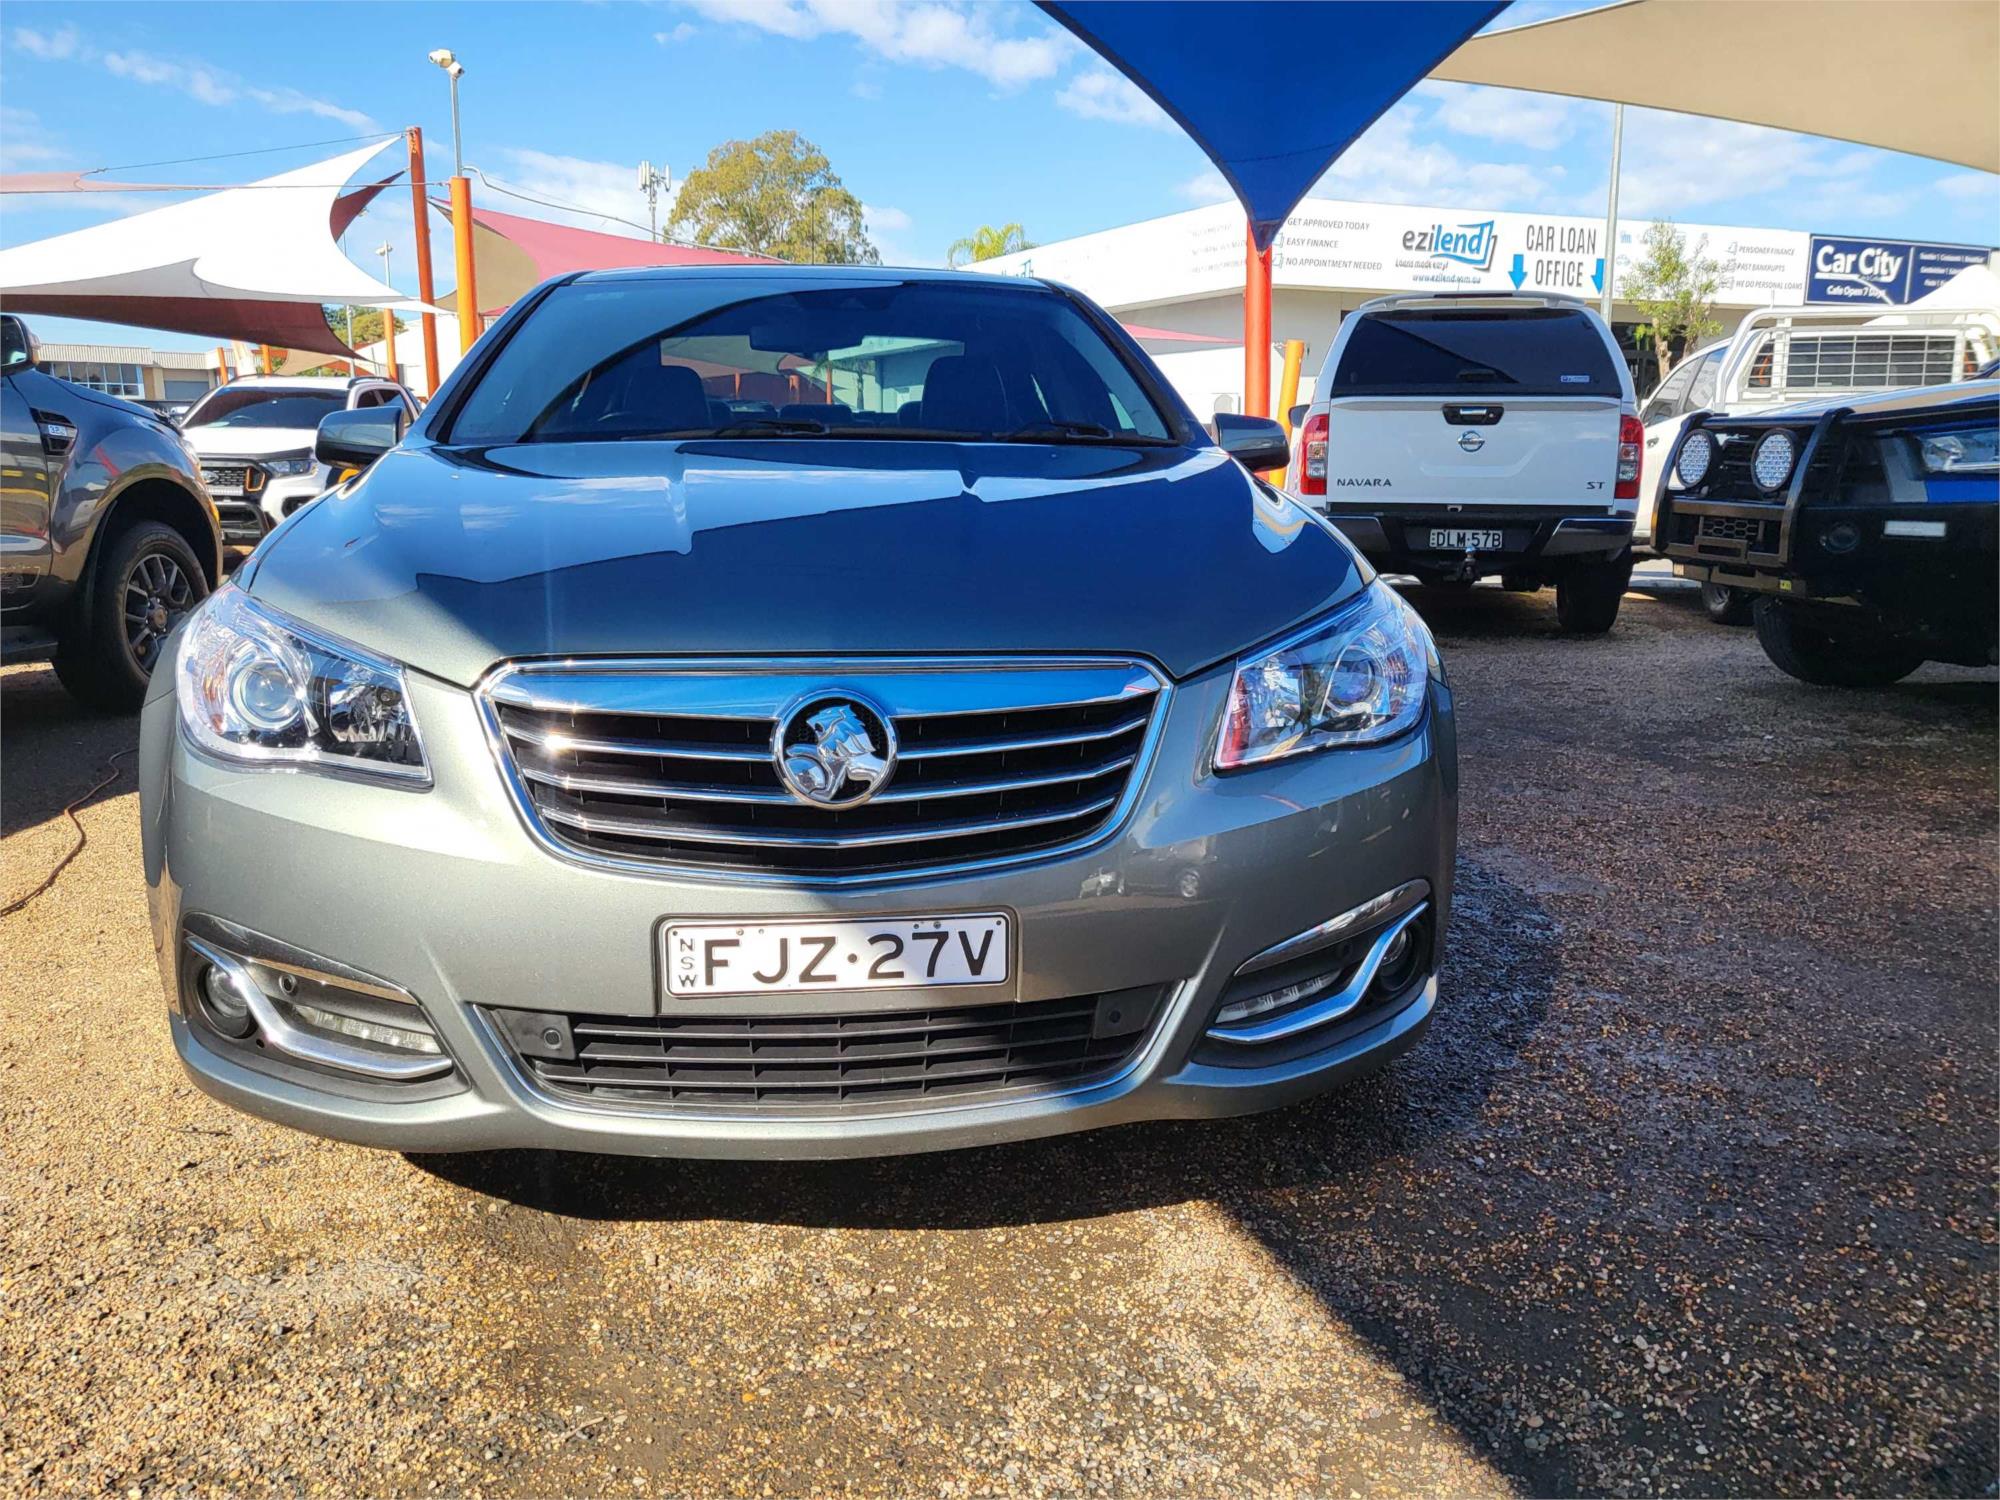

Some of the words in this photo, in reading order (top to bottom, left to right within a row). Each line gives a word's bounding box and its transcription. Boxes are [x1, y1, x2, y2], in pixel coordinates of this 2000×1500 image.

[1287, 217, 1302, 226] GET
[1303, 218, 1344, 230] APPROVED
[1345, 221, 1370, 231] TODAY
[1286, 237, 1306, 247] EASY
[1306, 238, 1339, 249] FINANCE
[1402, 223, 1487, 255] ezilend
[1526, 224, 1555, 251] CAR
[1559, 226, 1597, 255] LOAN
[1286, 257, 1298, 266] NO
[1298, 257, 1352, 269] APPOINTMENT
[1352, 260, 1383, 271] NEEDED
[1816, 244, 1857, 274] Car
[1858, 246, 1904, 283] City
[1535, 258, 1584, 288] OFFICE
[1755, 280, 1783, 290] PERSONAL
[1784, 281, 1803, 291] LOANS
[1336, 477, 1393, 487] NAVARA
[1585, 481, 1606, 490] ST
